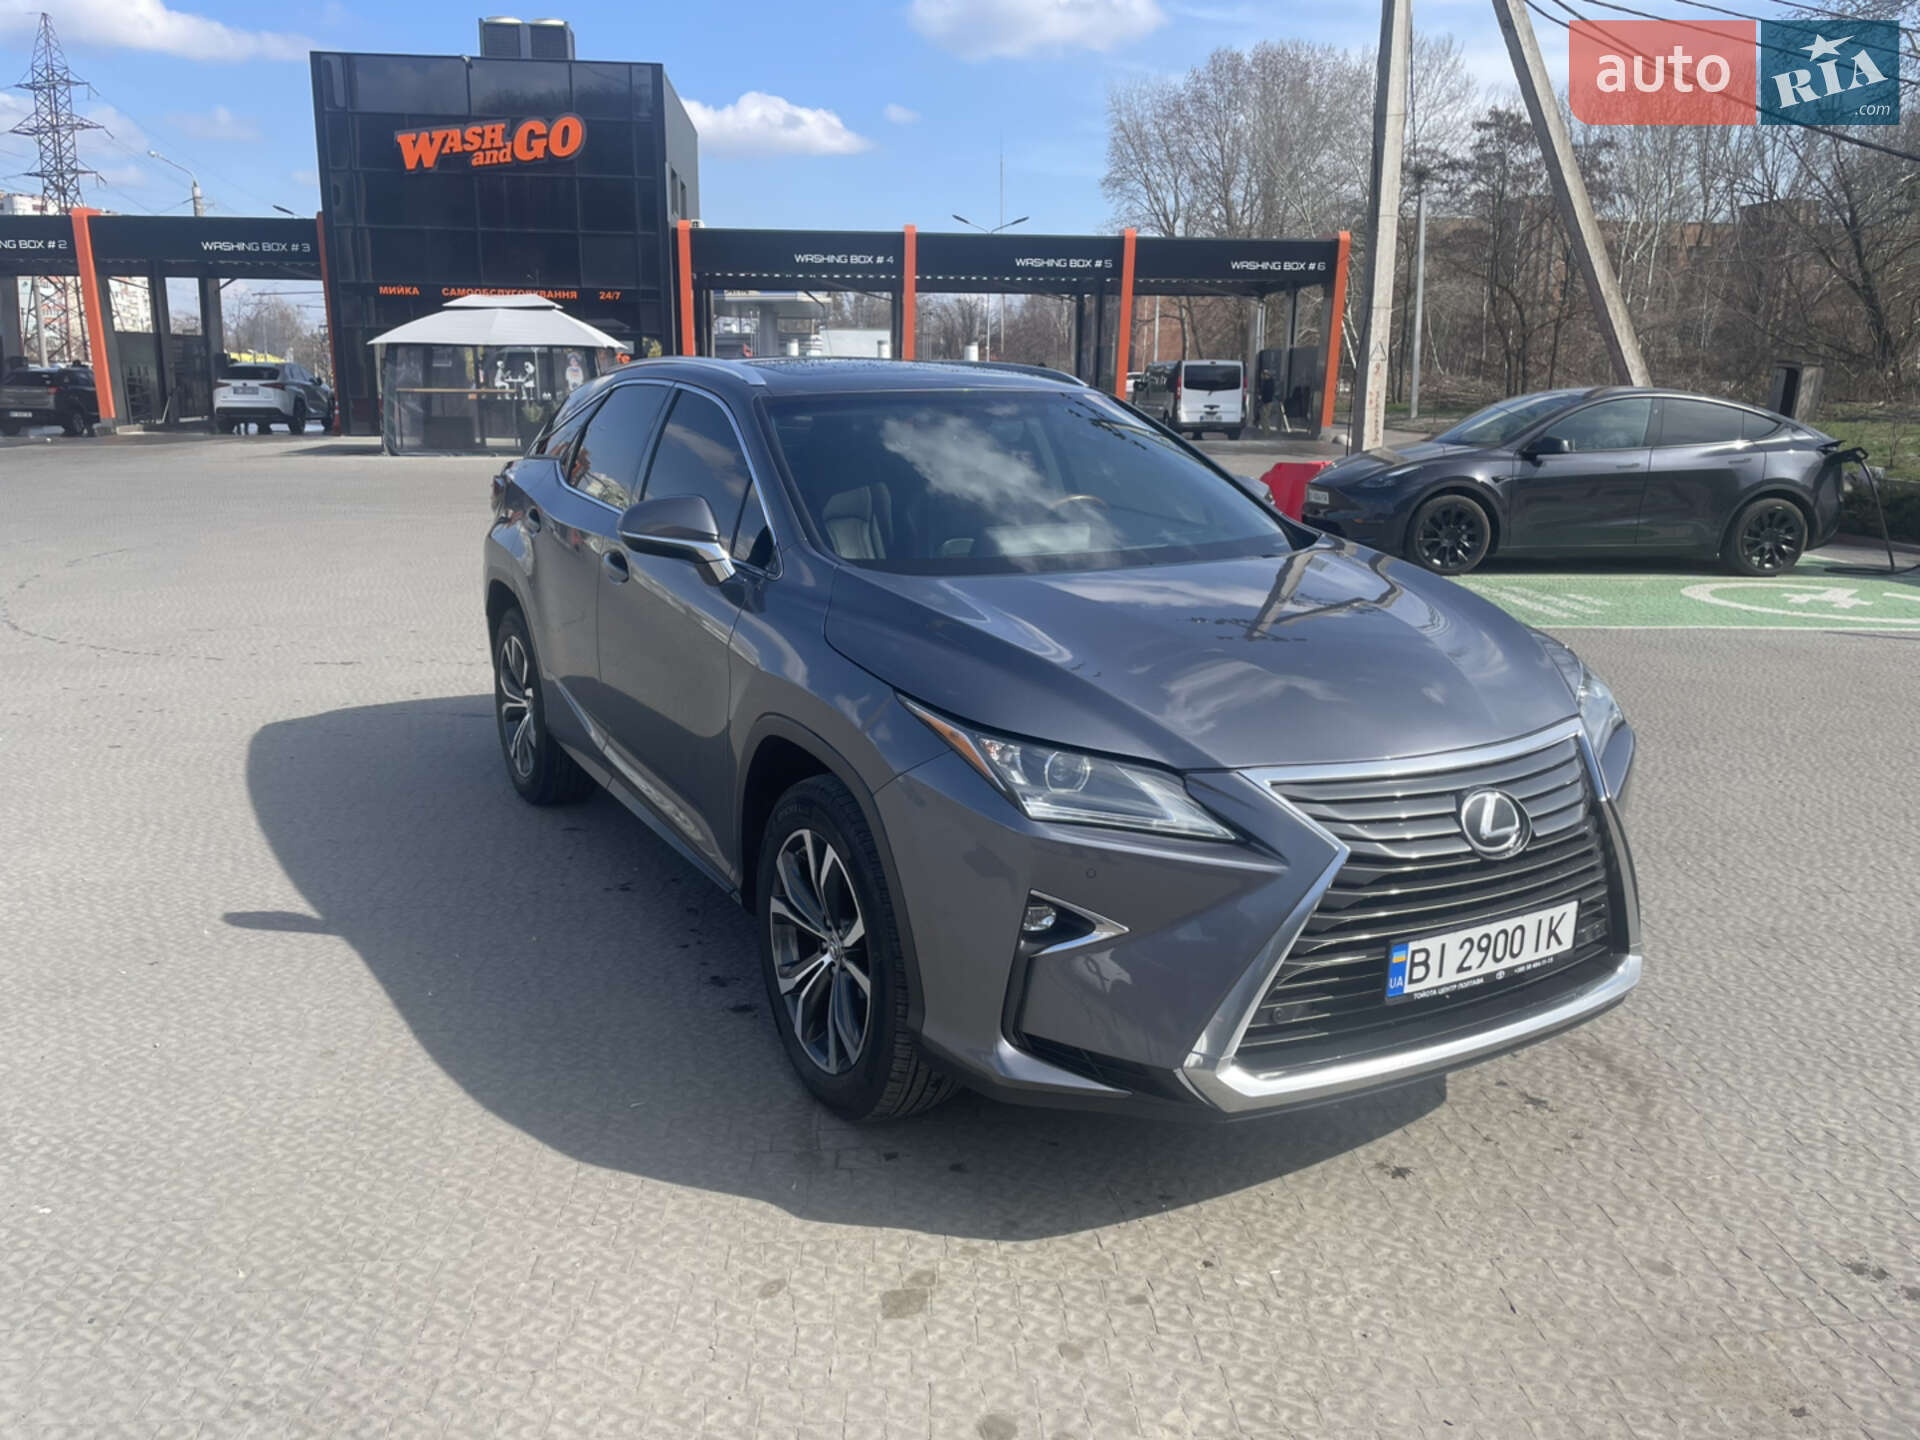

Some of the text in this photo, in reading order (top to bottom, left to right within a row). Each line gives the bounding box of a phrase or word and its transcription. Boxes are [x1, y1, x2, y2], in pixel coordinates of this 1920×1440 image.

[396, 115, 583, 171] WASH and GO
[19, 239, 45, 249] BOX
[201, 241, 260, 252] WASHING
[262, 242, 288, 252] BOX
[794, 254, 848, 265] WASHING
[850, 255, 874, 265] BOX
[1015, 258, 1068, 268] WASHING
[1069, 259, 1093, 268] BOX
[1231, 261, 1281, 271] WASHING
[1283, 261, 1306, 271] BOX
[379, 286, 420, 296] МИЙКА
[600, 290, 621, 301] 24/7
[1407, 911, 1568, 985] BI 2900 IK
[1388, 975, 1403, 990] UA
